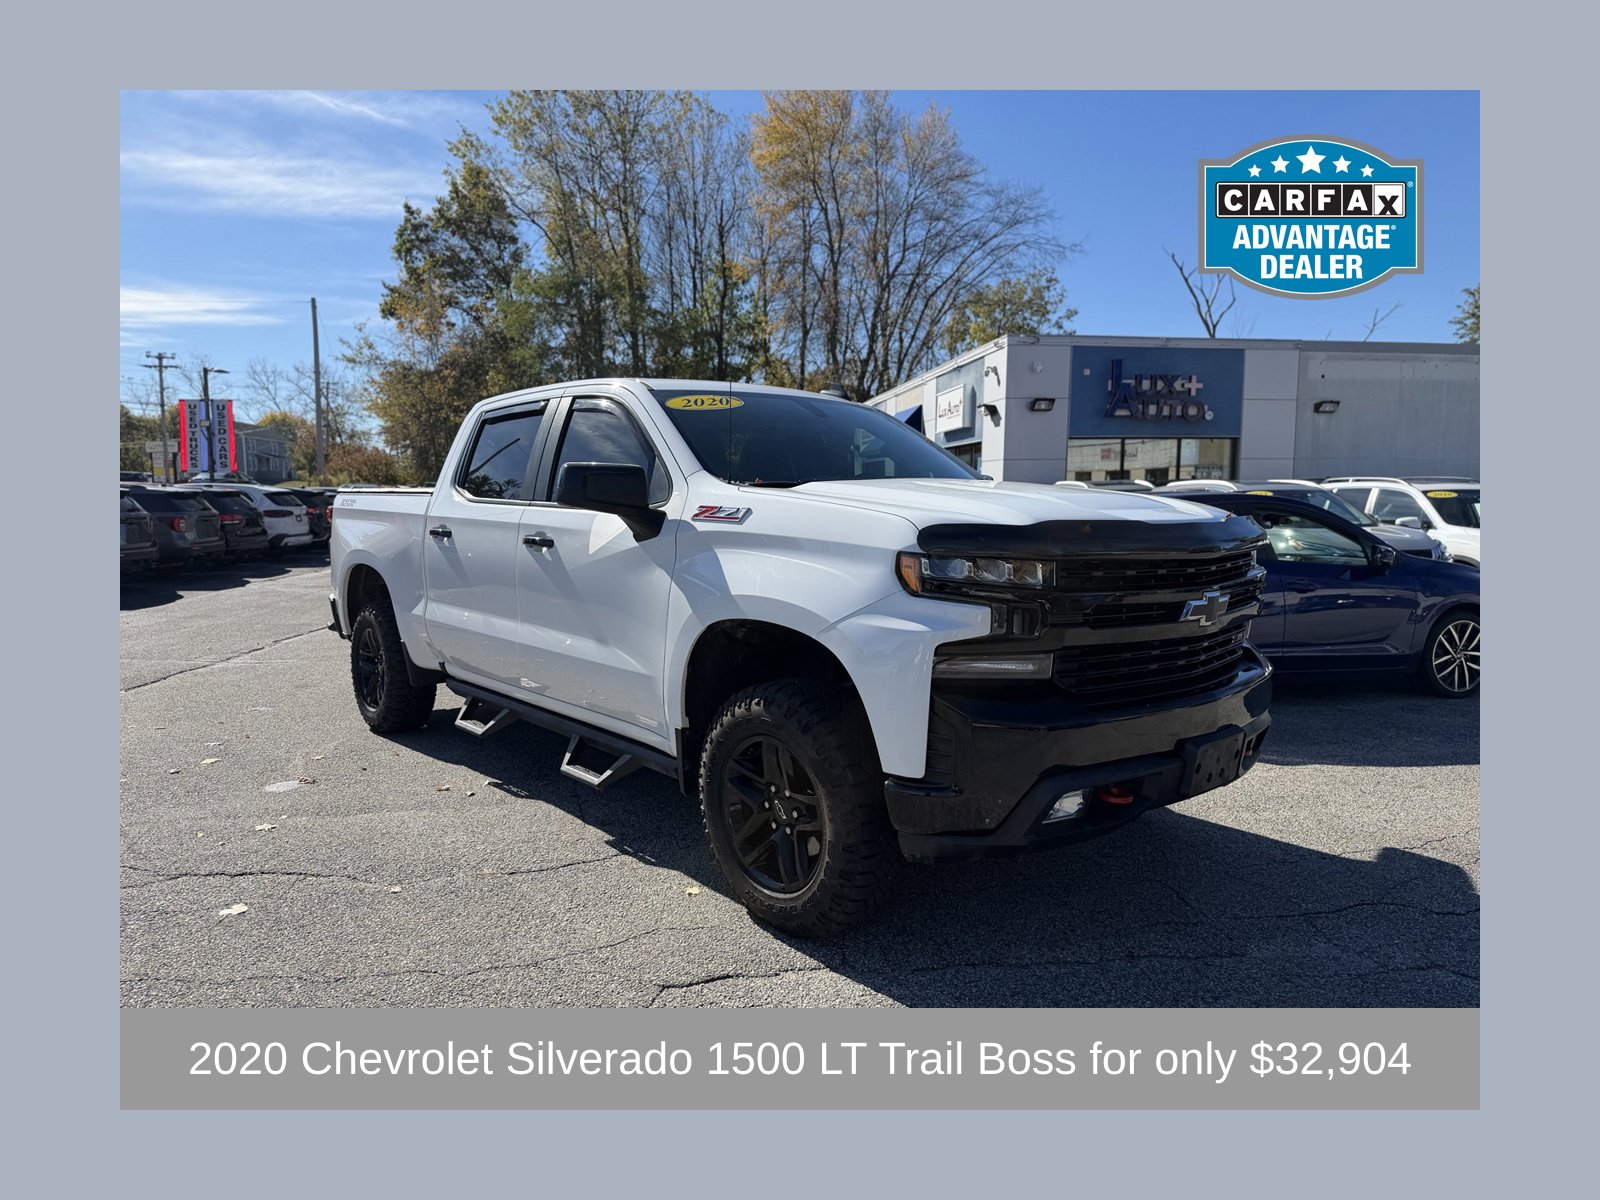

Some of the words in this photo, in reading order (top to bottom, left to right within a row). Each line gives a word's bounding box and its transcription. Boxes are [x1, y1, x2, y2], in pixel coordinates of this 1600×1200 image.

[188, 403, 197, 430] USED
[681, 396, 731, 408] 2020
[216, 404, 227, 436] USED
[189, 430, 199, 469] TRUCKS
[218, 437, 228, 469] CARS
[692, 505, 753, 523] Z71
